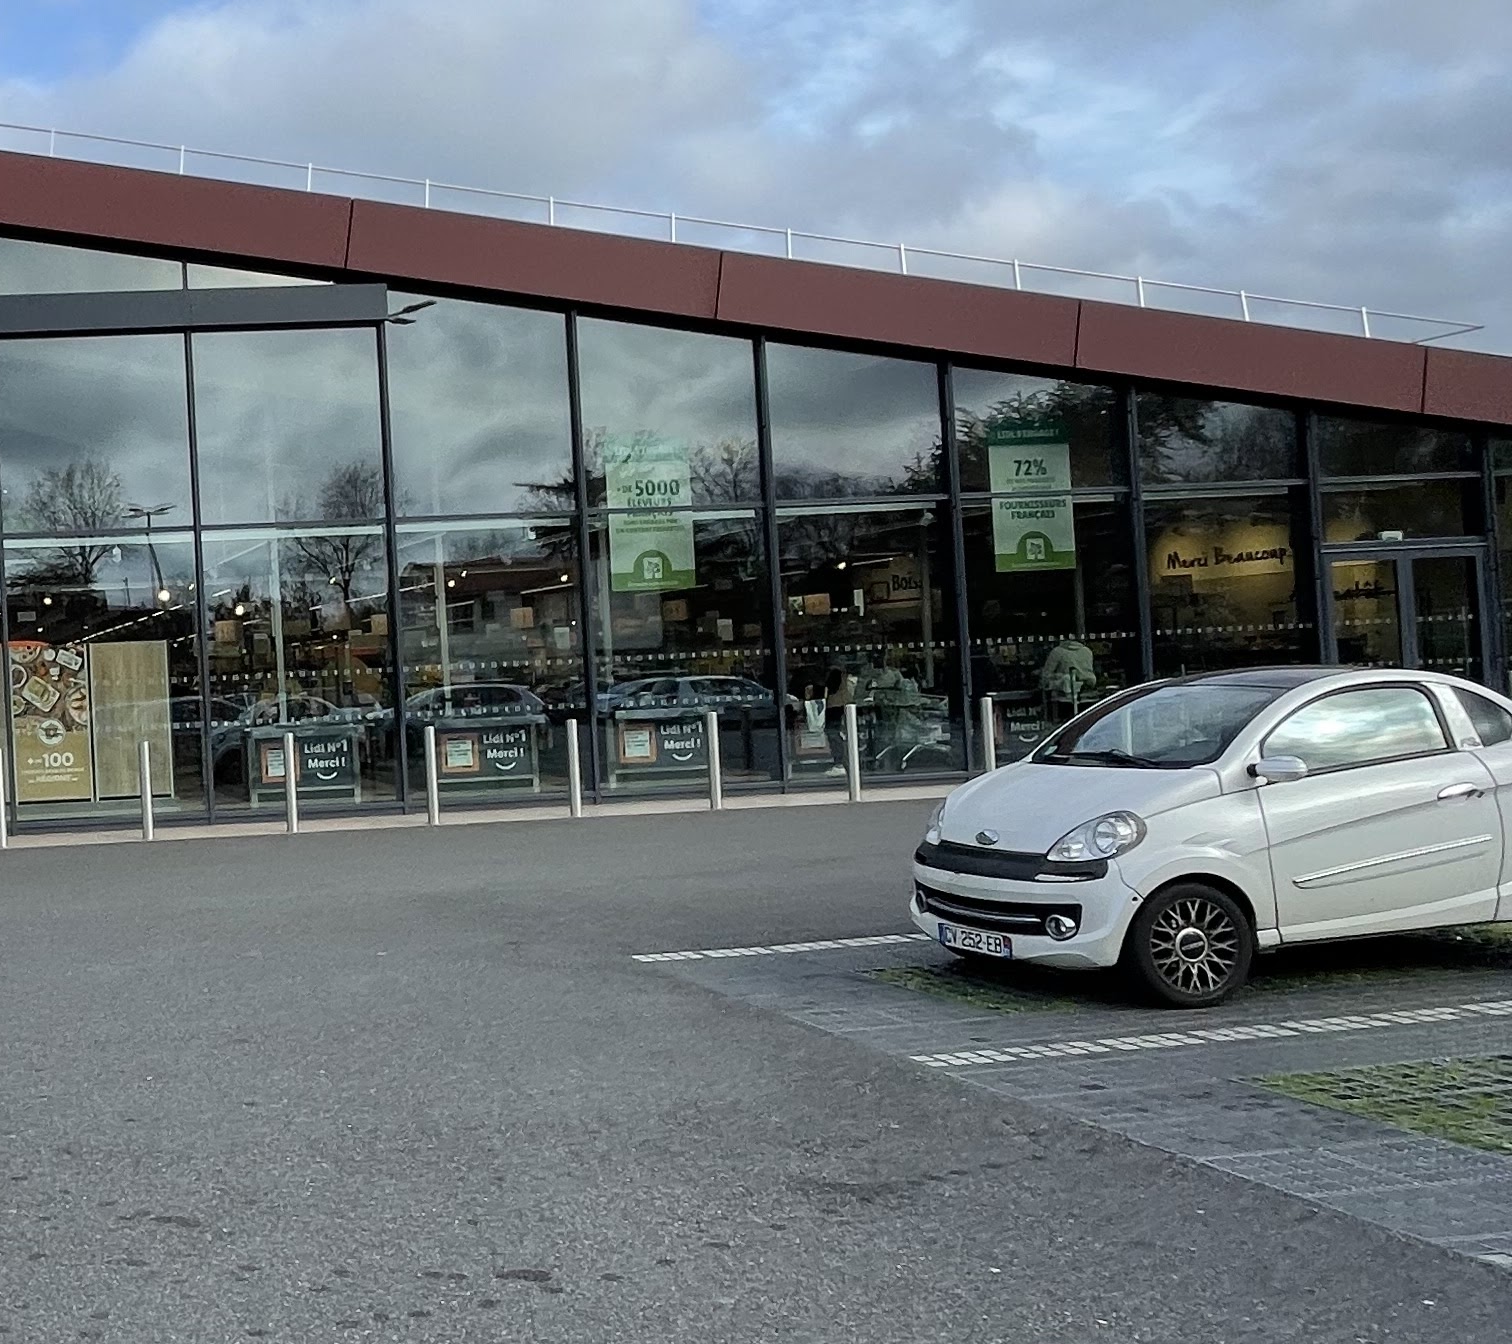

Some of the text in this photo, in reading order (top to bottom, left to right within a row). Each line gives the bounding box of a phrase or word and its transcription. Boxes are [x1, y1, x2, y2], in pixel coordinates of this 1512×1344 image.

[1013, 458, 1048, 476] 72%
[635, 478, 680, 496] 5000
[1167, 551, 1208, 569] Merci
[664, 737, 695, 749] Merci
[42, 752, 74, 767] 100
[486, 747, 518, 759] Merci
[308, 756, 340, 768] Merci
